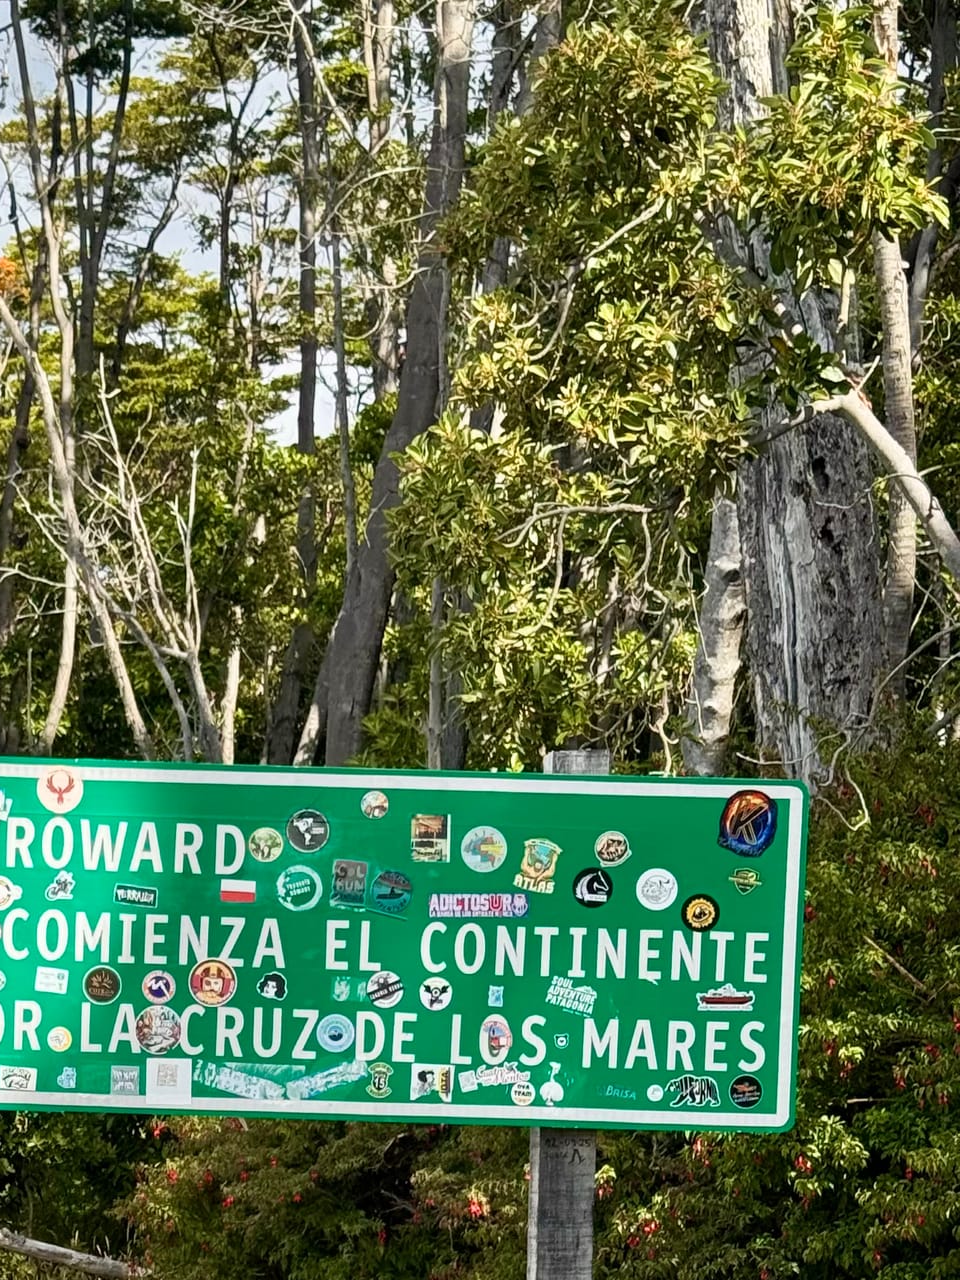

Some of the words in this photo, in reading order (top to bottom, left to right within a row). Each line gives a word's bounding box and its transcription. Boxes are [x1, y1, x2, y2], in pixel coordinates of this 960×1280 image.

[514, 874, 555, 894] ATLAS
[429, 893, 512, 912] ADICTOSUR
[2, 908, 286, 969] COMIENZA
[325, 919, 381, 972] EL
[420, 922, 770, 983] CONTINENTE
[551, 975, 574, 989] SOUL
[545, 994, 594, 1015] PATAGONIA
[547, 985, 596, 1004] ADVENTURE
[80, 1001, 142, 1054] LA
[179, 1003, 319, 1060] CRUZ
[354, 1010, 418, 1063] DE
[450, 1013, 547, 1067] LOS
[581, 1018, 766, 1073] MARES
